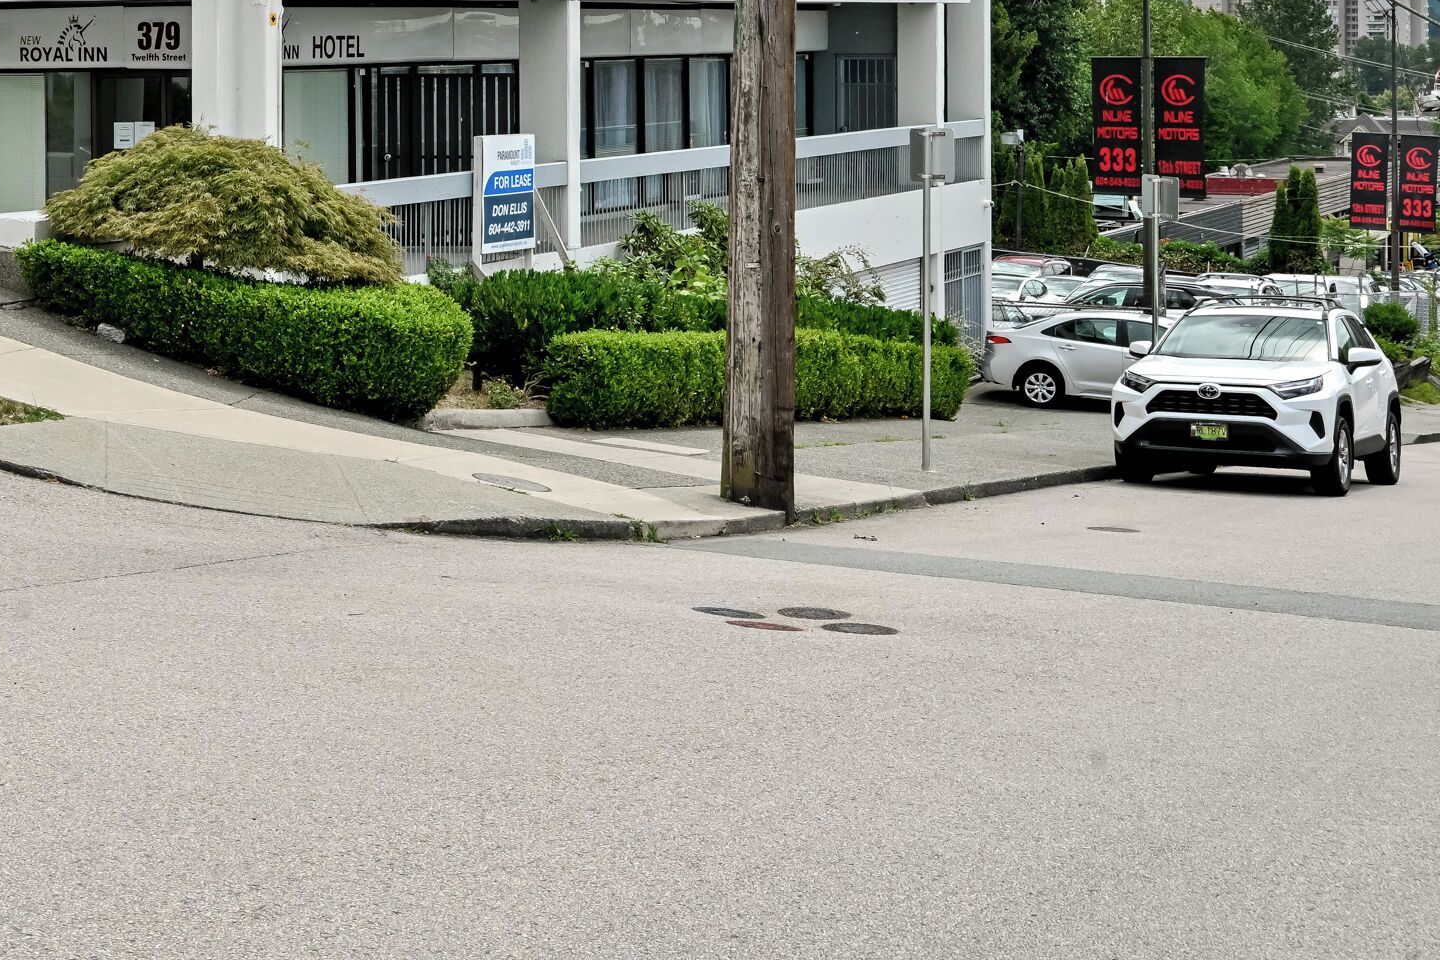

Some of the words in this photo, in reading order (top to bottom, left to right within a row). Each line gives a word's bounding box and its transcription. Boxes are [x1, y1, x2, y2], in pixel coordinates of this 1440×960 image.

[20, 35, 41, 46] NEW
[137, 21, 181, 51] 379
[20, 46, 74, 62] ROYAL
[78, 46, 108, 62] INN
[282, 44, 300, 60] NN
[312, 34, 365, 59] HOTEL
[131, 52, 160, 62] Twelfth
[161, 53, 187, 62] Street
[1097, 126, 1139, 140] MOTORS
[1158, 127, 1200, 141] MOTORS
[1099, 147, 1137, 172] 333
[1174, 160, 1201, 175] STREET
[494, 175, 510, 190] FOR
[510, 173, 533, 188] LEASE
[492, 203, 510, 217] DON
[509, 201, 528, 215] ELLIS
[1402, 198, 1432, 218] 333
[488, 220, 530, 235] 604-442-3911
